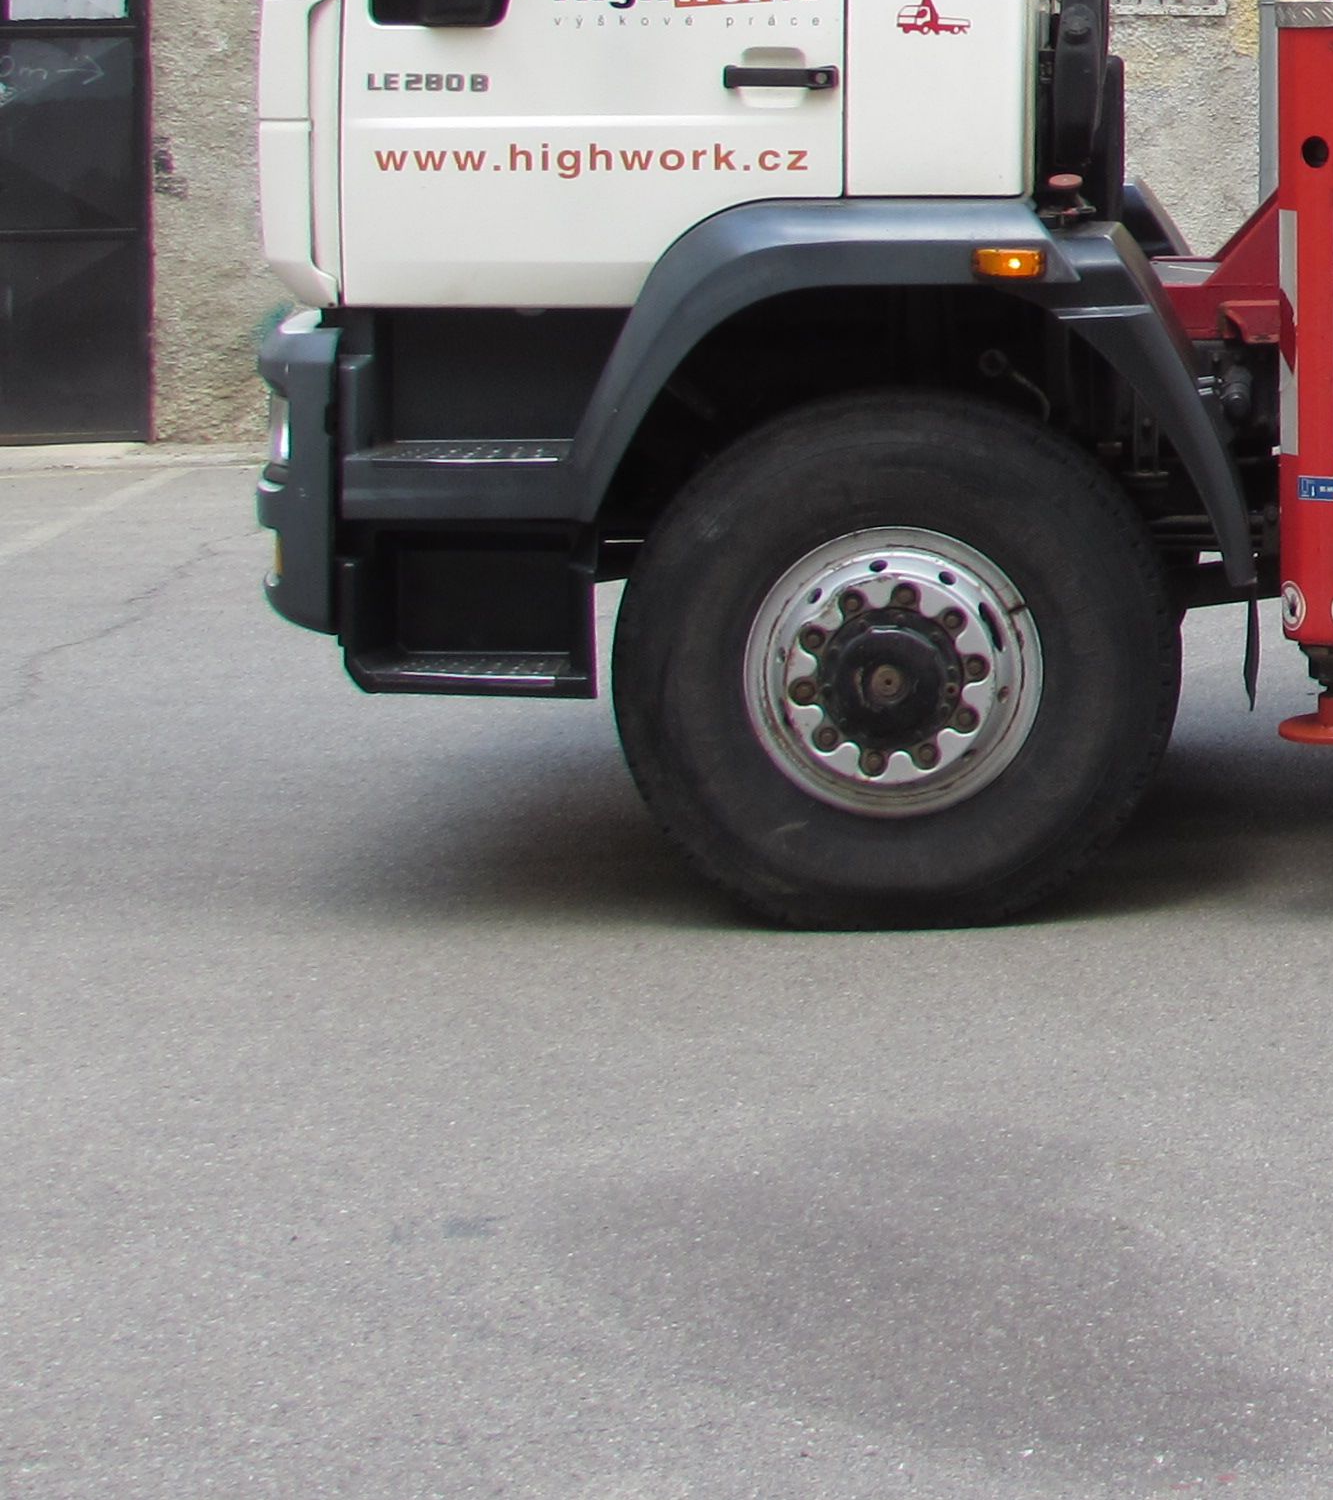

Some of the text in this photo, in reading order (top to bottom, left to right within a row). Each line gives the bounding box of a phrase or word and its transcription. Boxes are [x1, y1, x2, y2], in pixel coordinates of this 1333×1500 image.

[554, 14, 820, 29] výškové práce
[367, 73, 399, 90] LE
[404, 74, 464, 91] 280
[374, 143, 808, 179] www.highwork.cz
